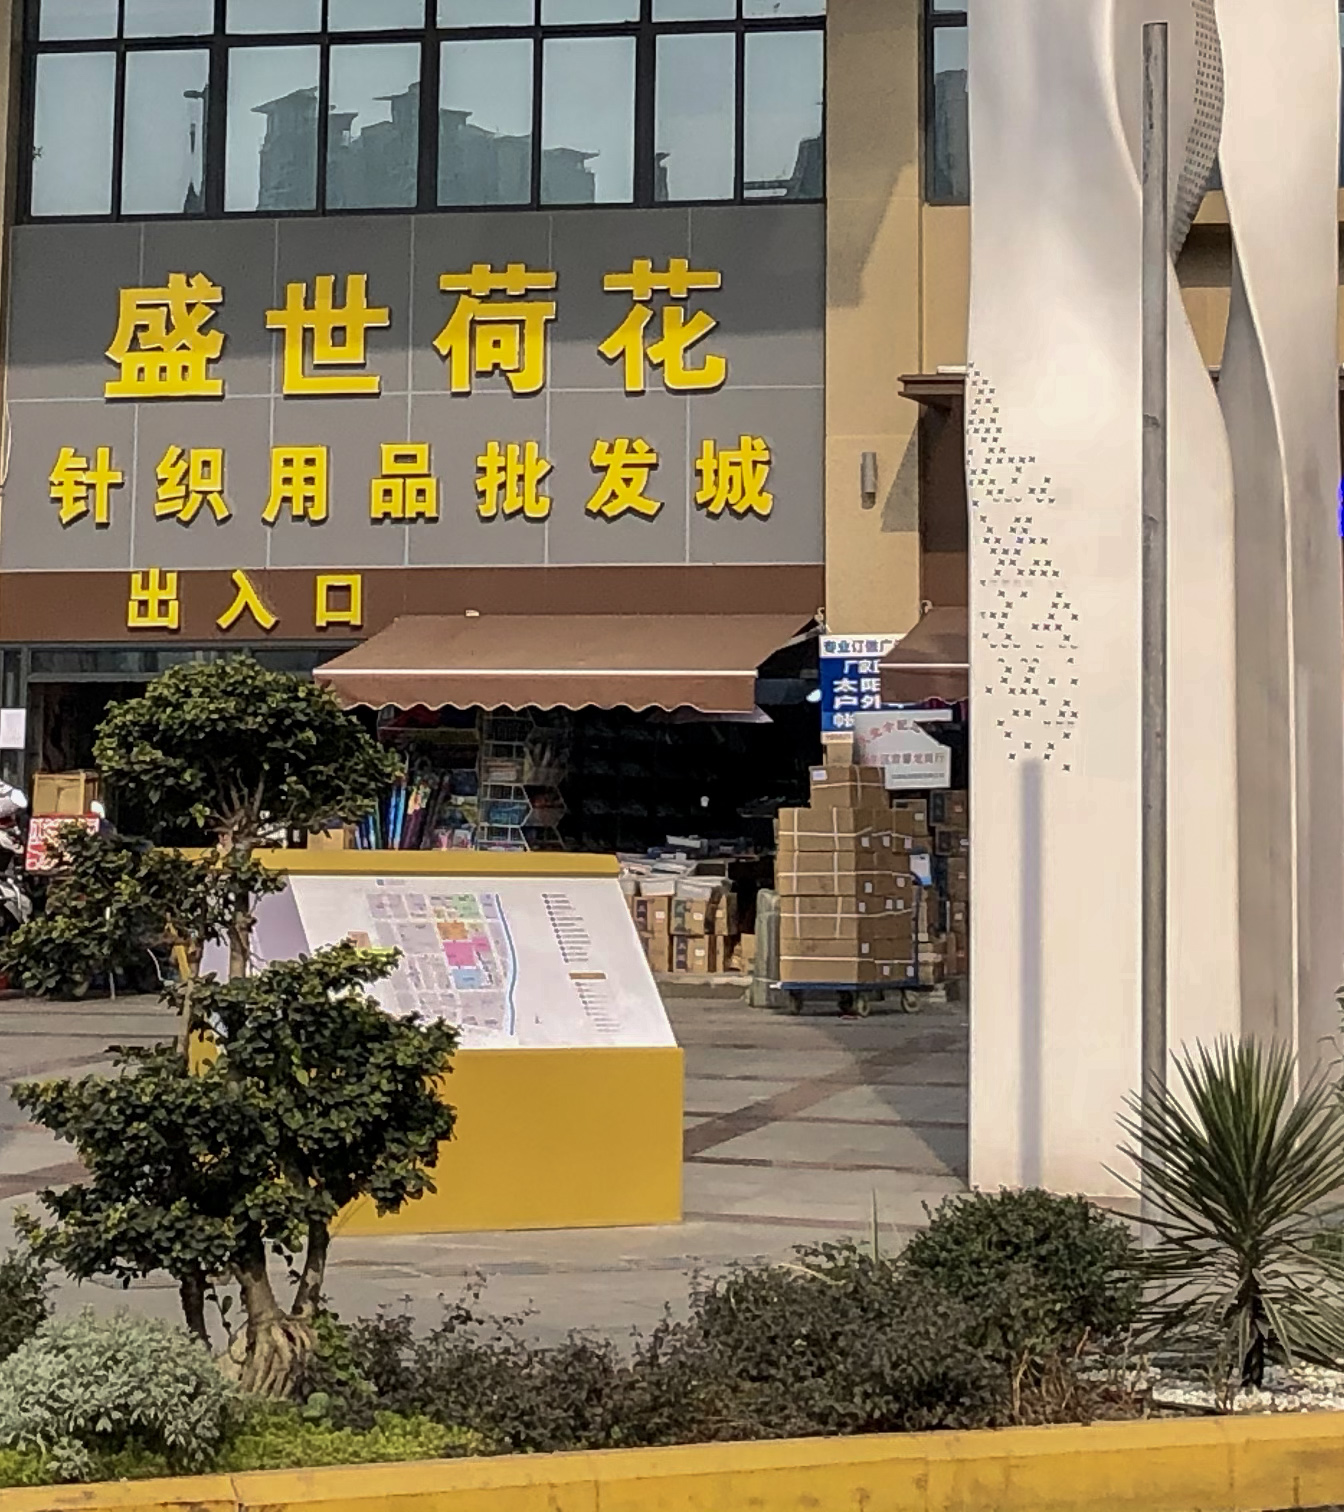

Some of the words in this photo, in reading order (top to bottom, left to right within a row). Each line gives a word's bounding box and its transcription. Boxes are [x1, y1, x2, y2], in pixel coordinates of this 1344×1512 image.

[104, 257, 728, 399] 盛世荷花
[49, 436, 774, 527] 针织用品批发城
[126, 568, 364, 631] 出入口
